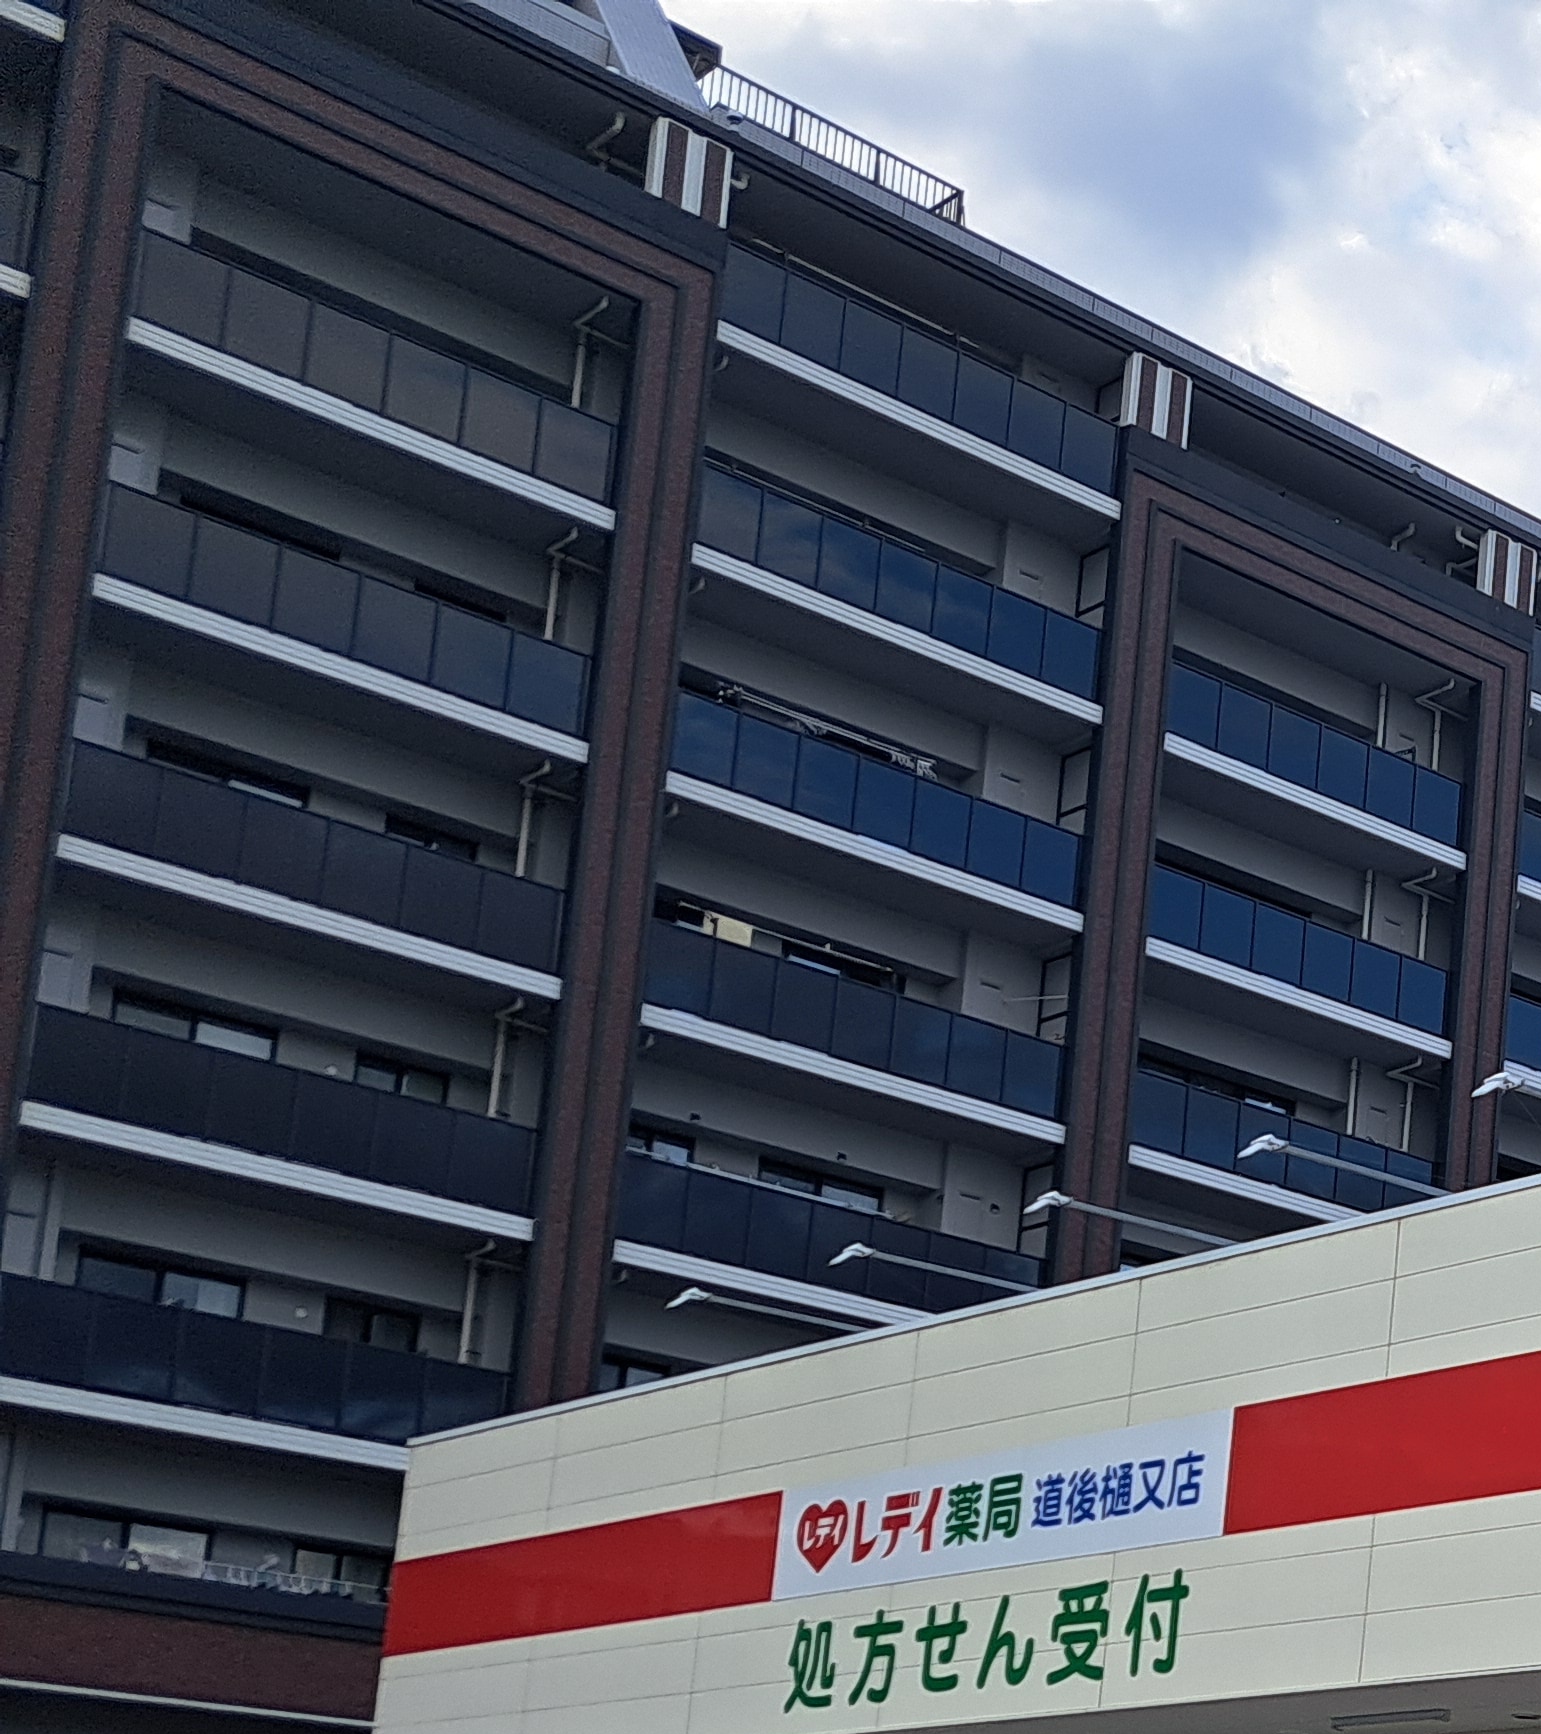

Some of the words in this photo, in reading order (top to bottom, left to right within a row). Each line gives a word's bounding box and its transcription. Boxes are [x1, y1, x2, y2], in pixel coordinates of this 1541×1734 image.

[1030, 1448, 1205, 1529] 道後樋又店
[782, 1566, 1191, 1716] 処方せん受付
